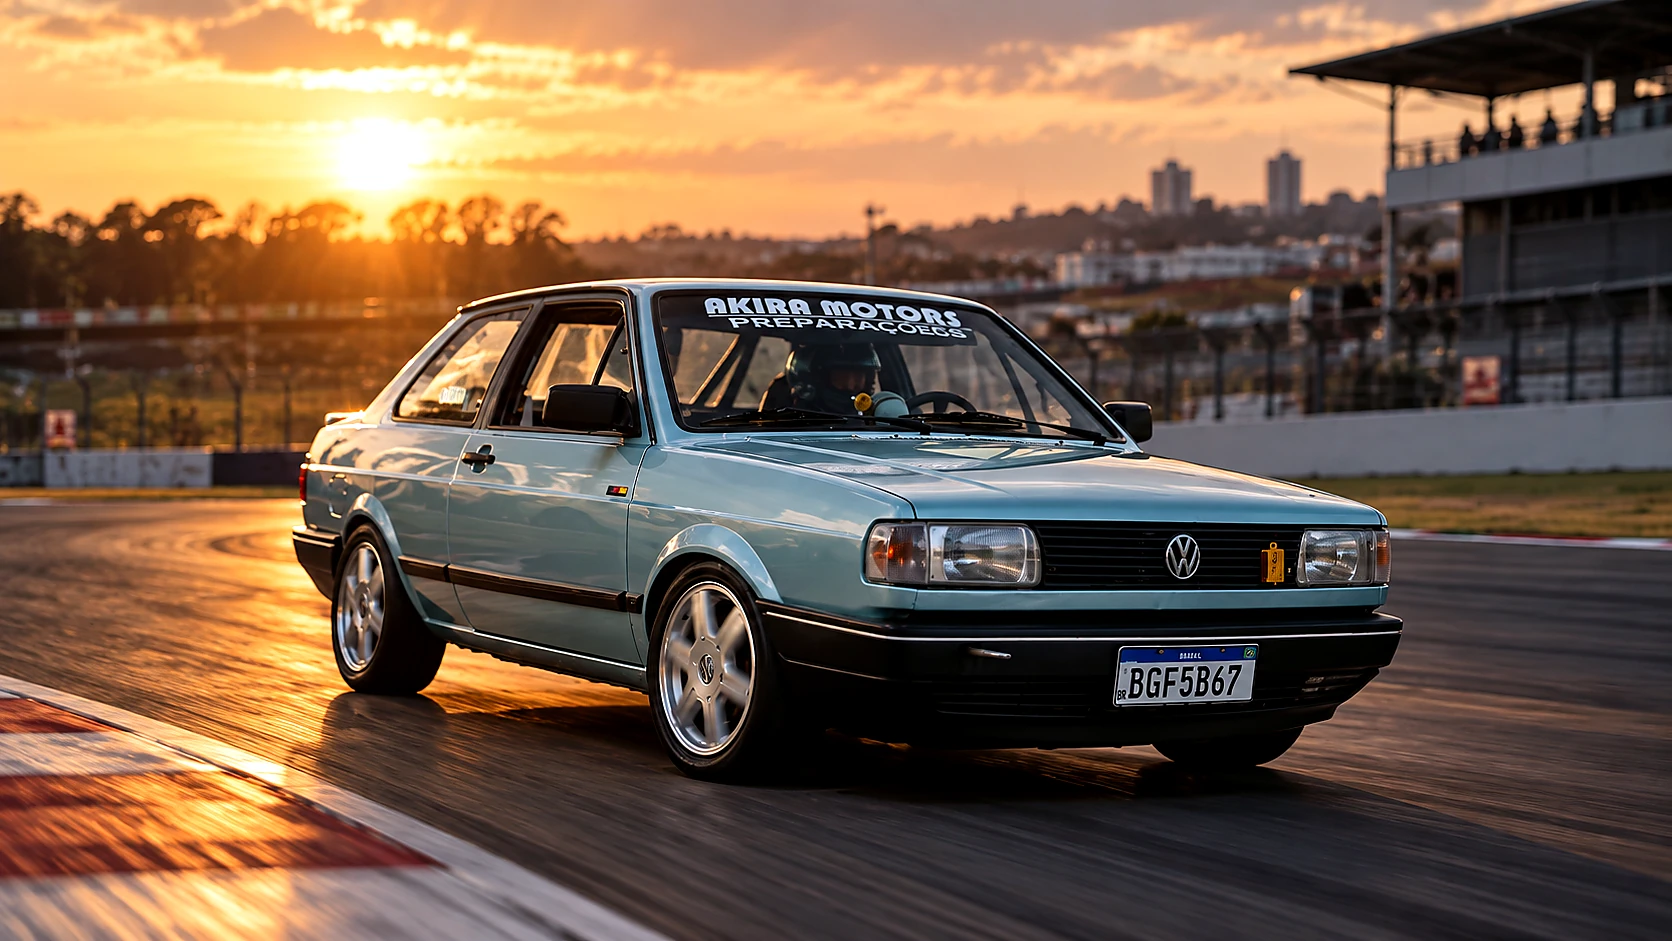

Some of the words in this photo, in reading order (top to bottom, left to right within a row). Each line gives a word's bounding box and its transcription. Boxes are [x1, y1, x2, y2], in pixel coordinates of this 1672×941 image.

[704, 297, 812, 316] AKIRA
[820, 300, 962, 328] MOTORS
[1128, 664, 1243, 699] BGF5B67
